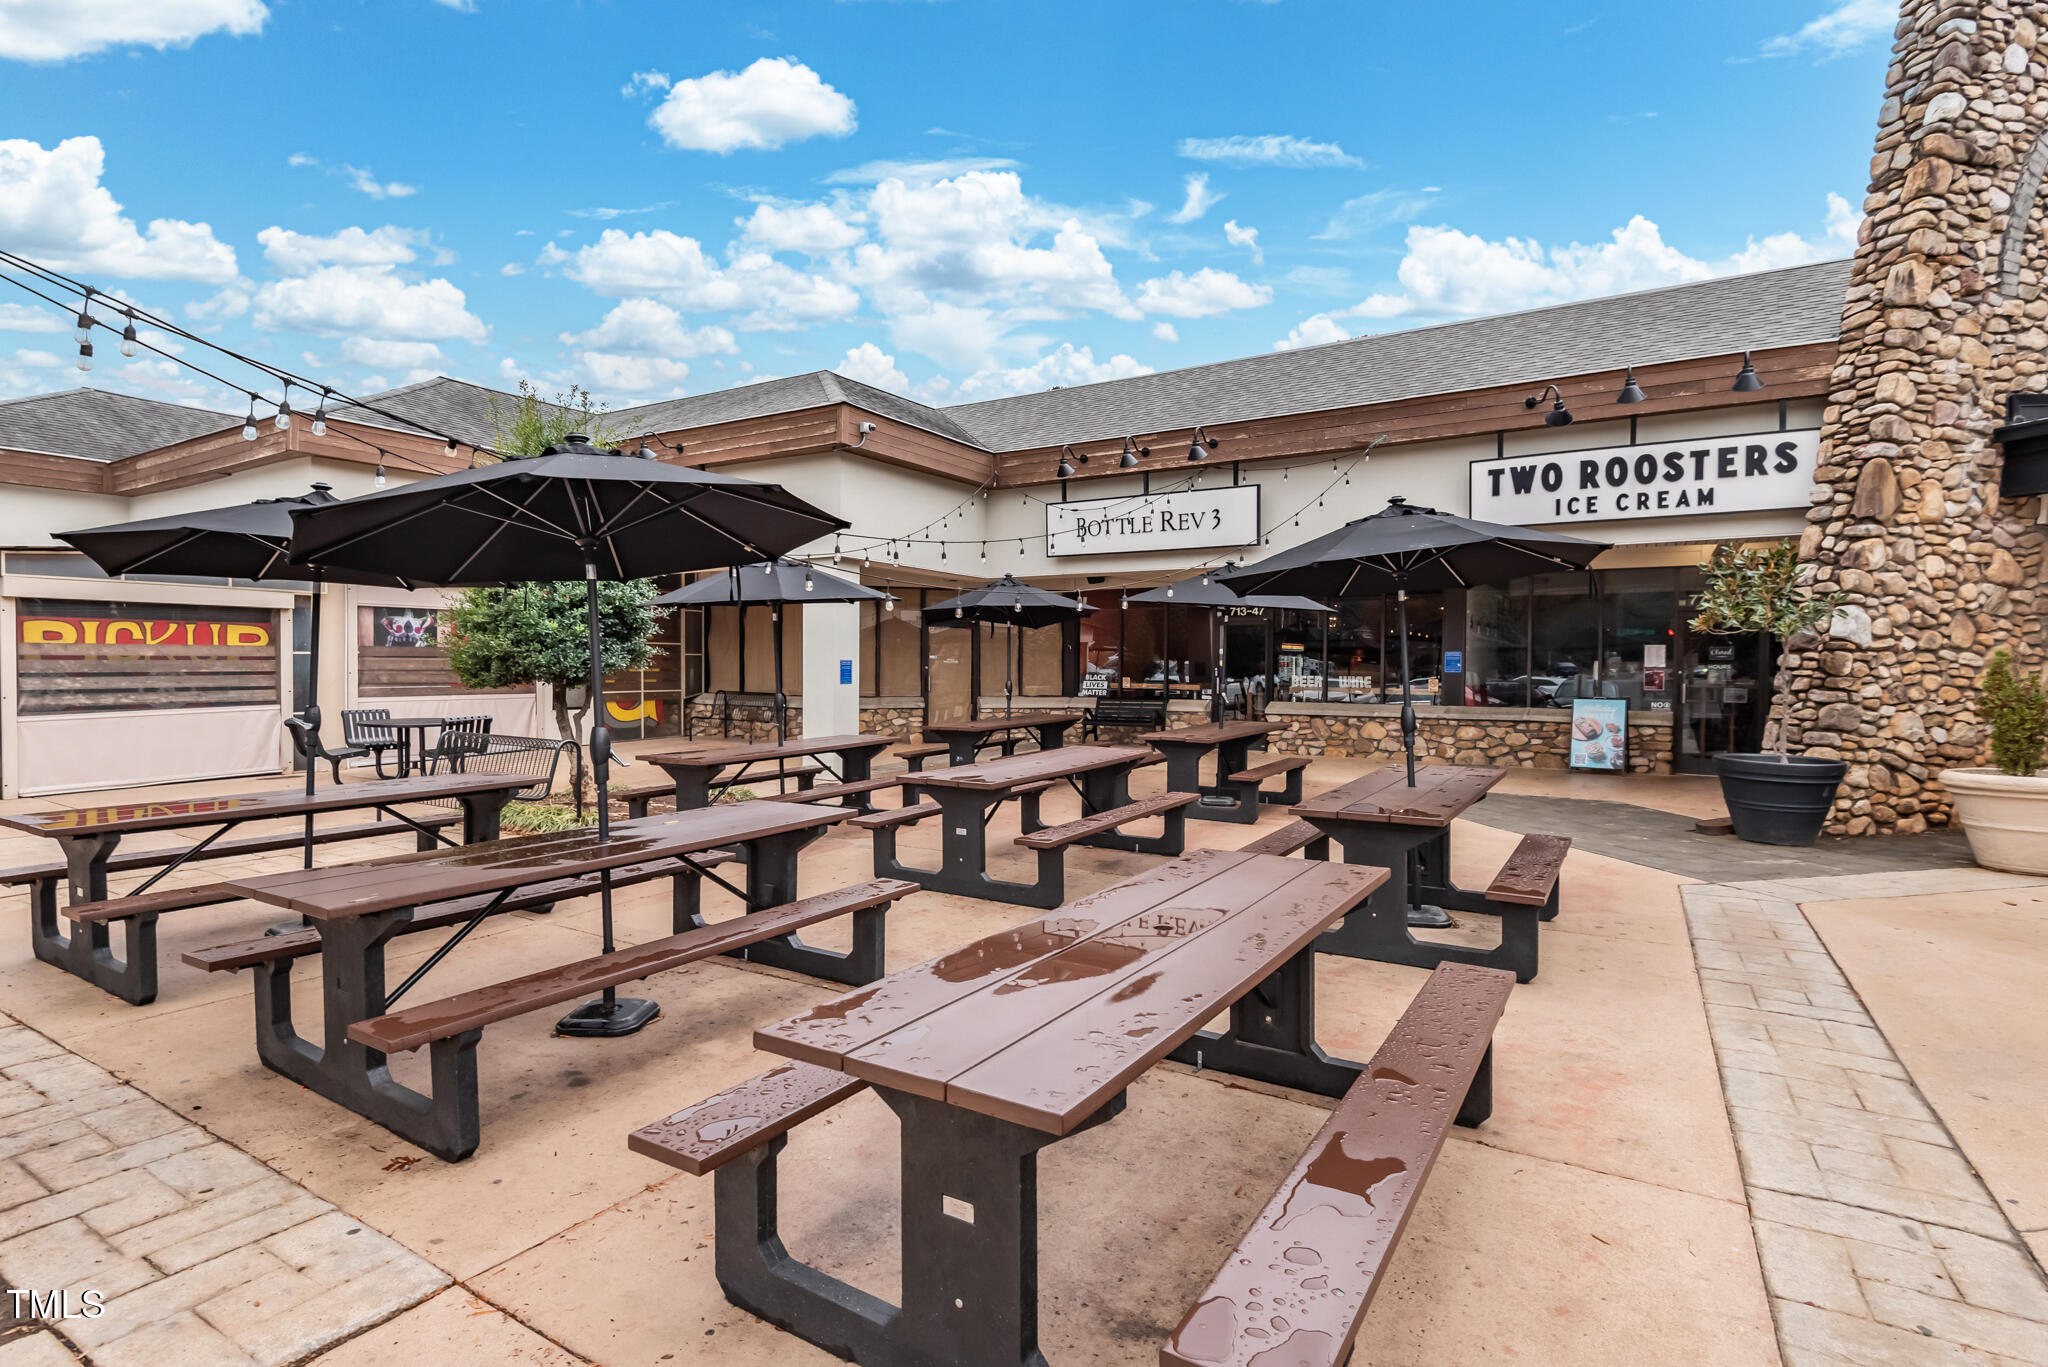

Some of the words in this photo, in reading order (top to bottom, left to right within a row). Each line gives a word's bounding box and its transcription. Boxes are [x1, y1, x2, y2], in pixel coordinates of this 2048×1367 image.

[1487, 461, 1564, 497] TWO
[1579, 441, 1799, 490] ROOSTERS
[1555, 496, 1598, 516] ICE
[1615, 487, 1715, 512] CREAM
[1076, 515, 1154, 538] BOTTLE
[1160, 510, 1206, 532] REV
[1211, 508, 1221, 530] 3
[1291, 675, 1323, 688] BEER
